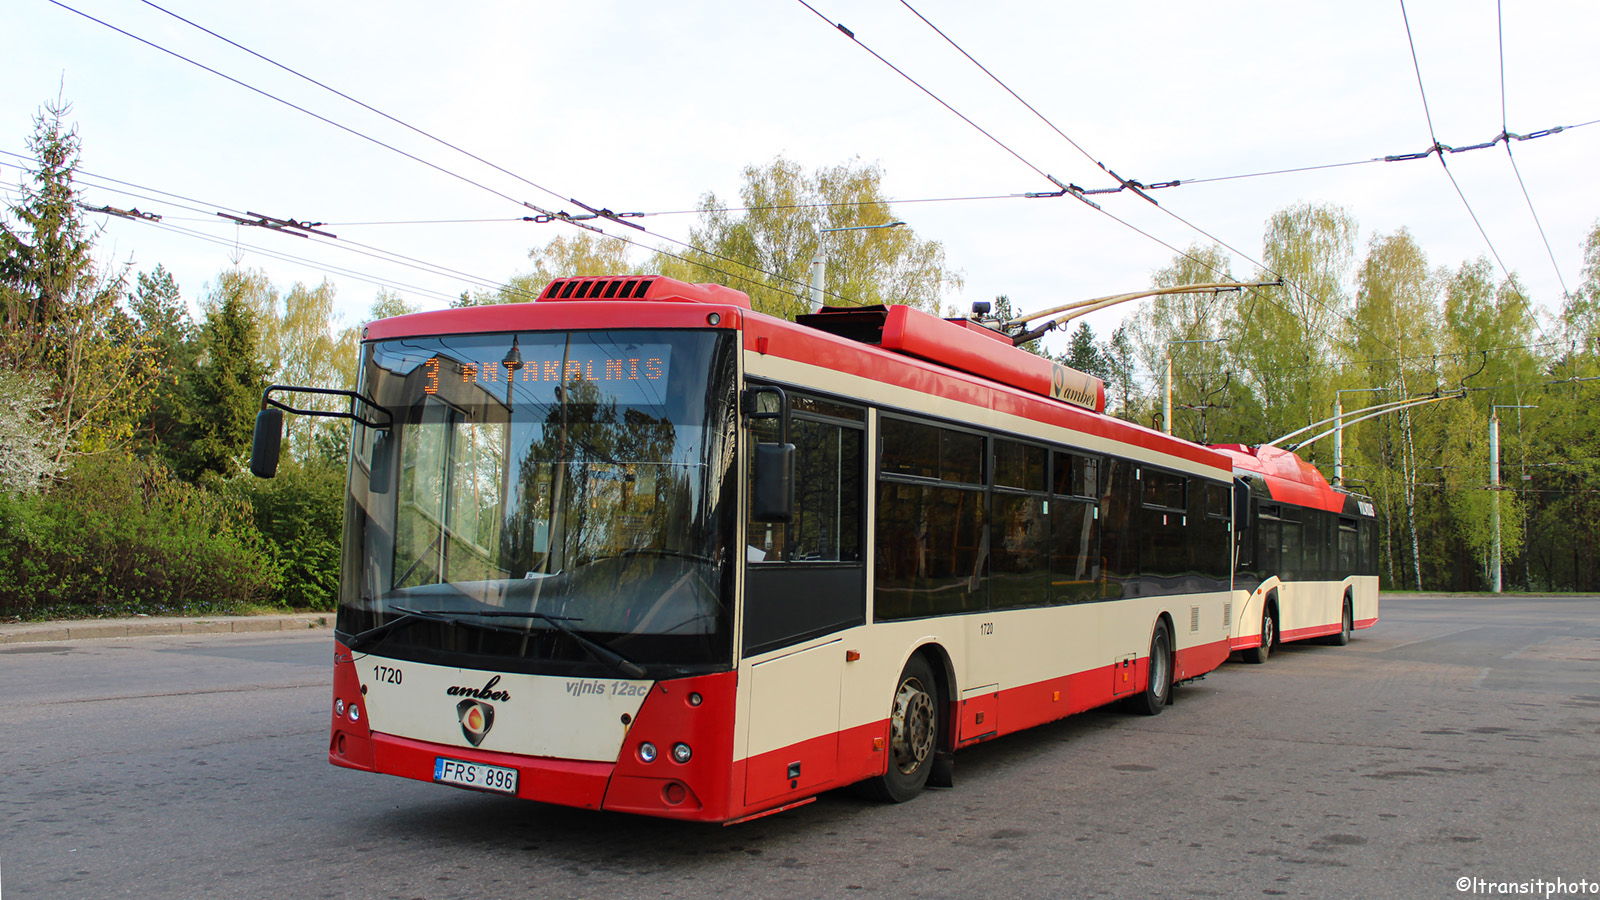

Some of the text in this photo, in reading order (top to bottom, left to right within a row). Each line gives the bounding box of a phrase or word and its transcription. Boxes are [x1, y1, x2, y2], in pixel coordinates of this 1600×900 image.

[424, 357, 663, 395] 3 ANTAKALNIS
[1063, 376, 1096, 407] amber
[980, 622, 994, 636] 1720
[373, 665, 403, 685] 1720
[446, 674, 511, 702] amber
[611, 681, 647, 697] 12ac
[443, 761, 513, 790] FRS 896
